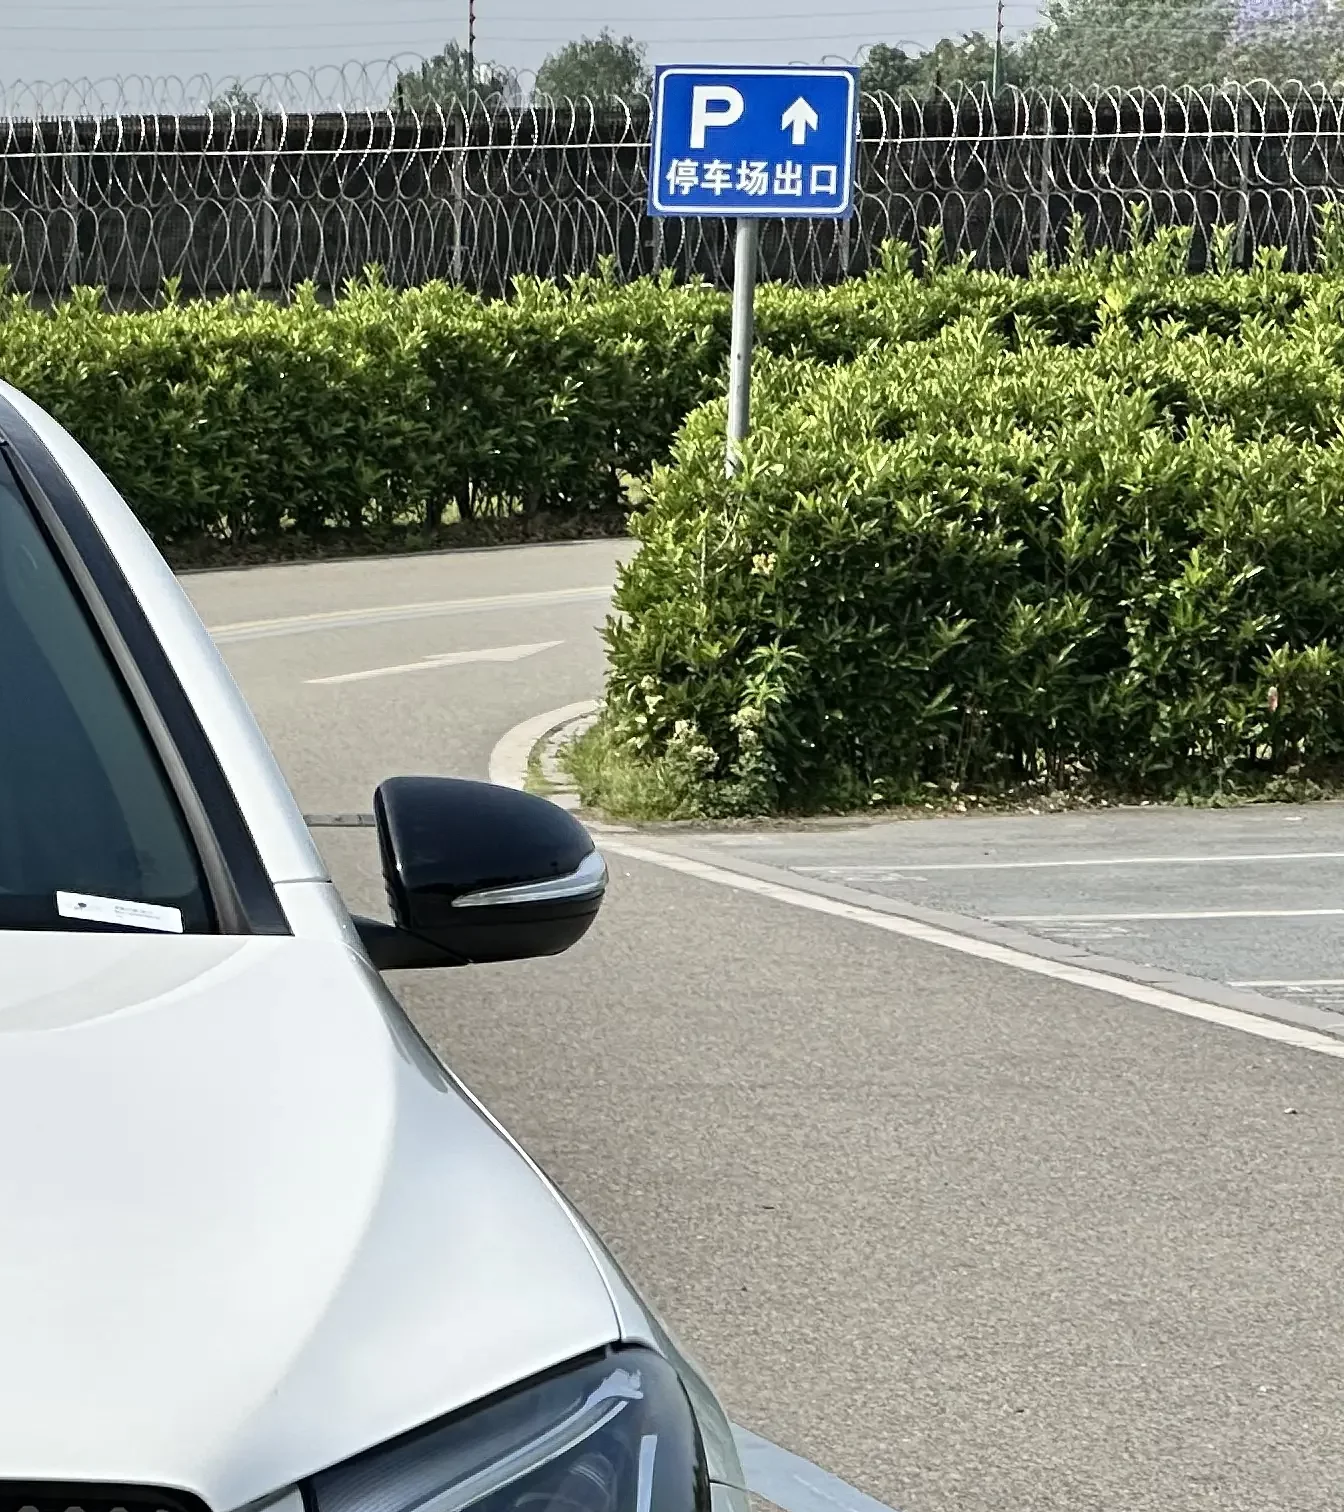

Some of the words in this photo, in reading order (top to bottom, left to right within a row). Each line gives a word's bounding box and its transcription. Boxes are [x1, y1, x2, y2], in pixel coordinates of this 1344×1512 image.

[689, 85, 745, 149] P
[665, 157, 838, 197] 停车场出口
